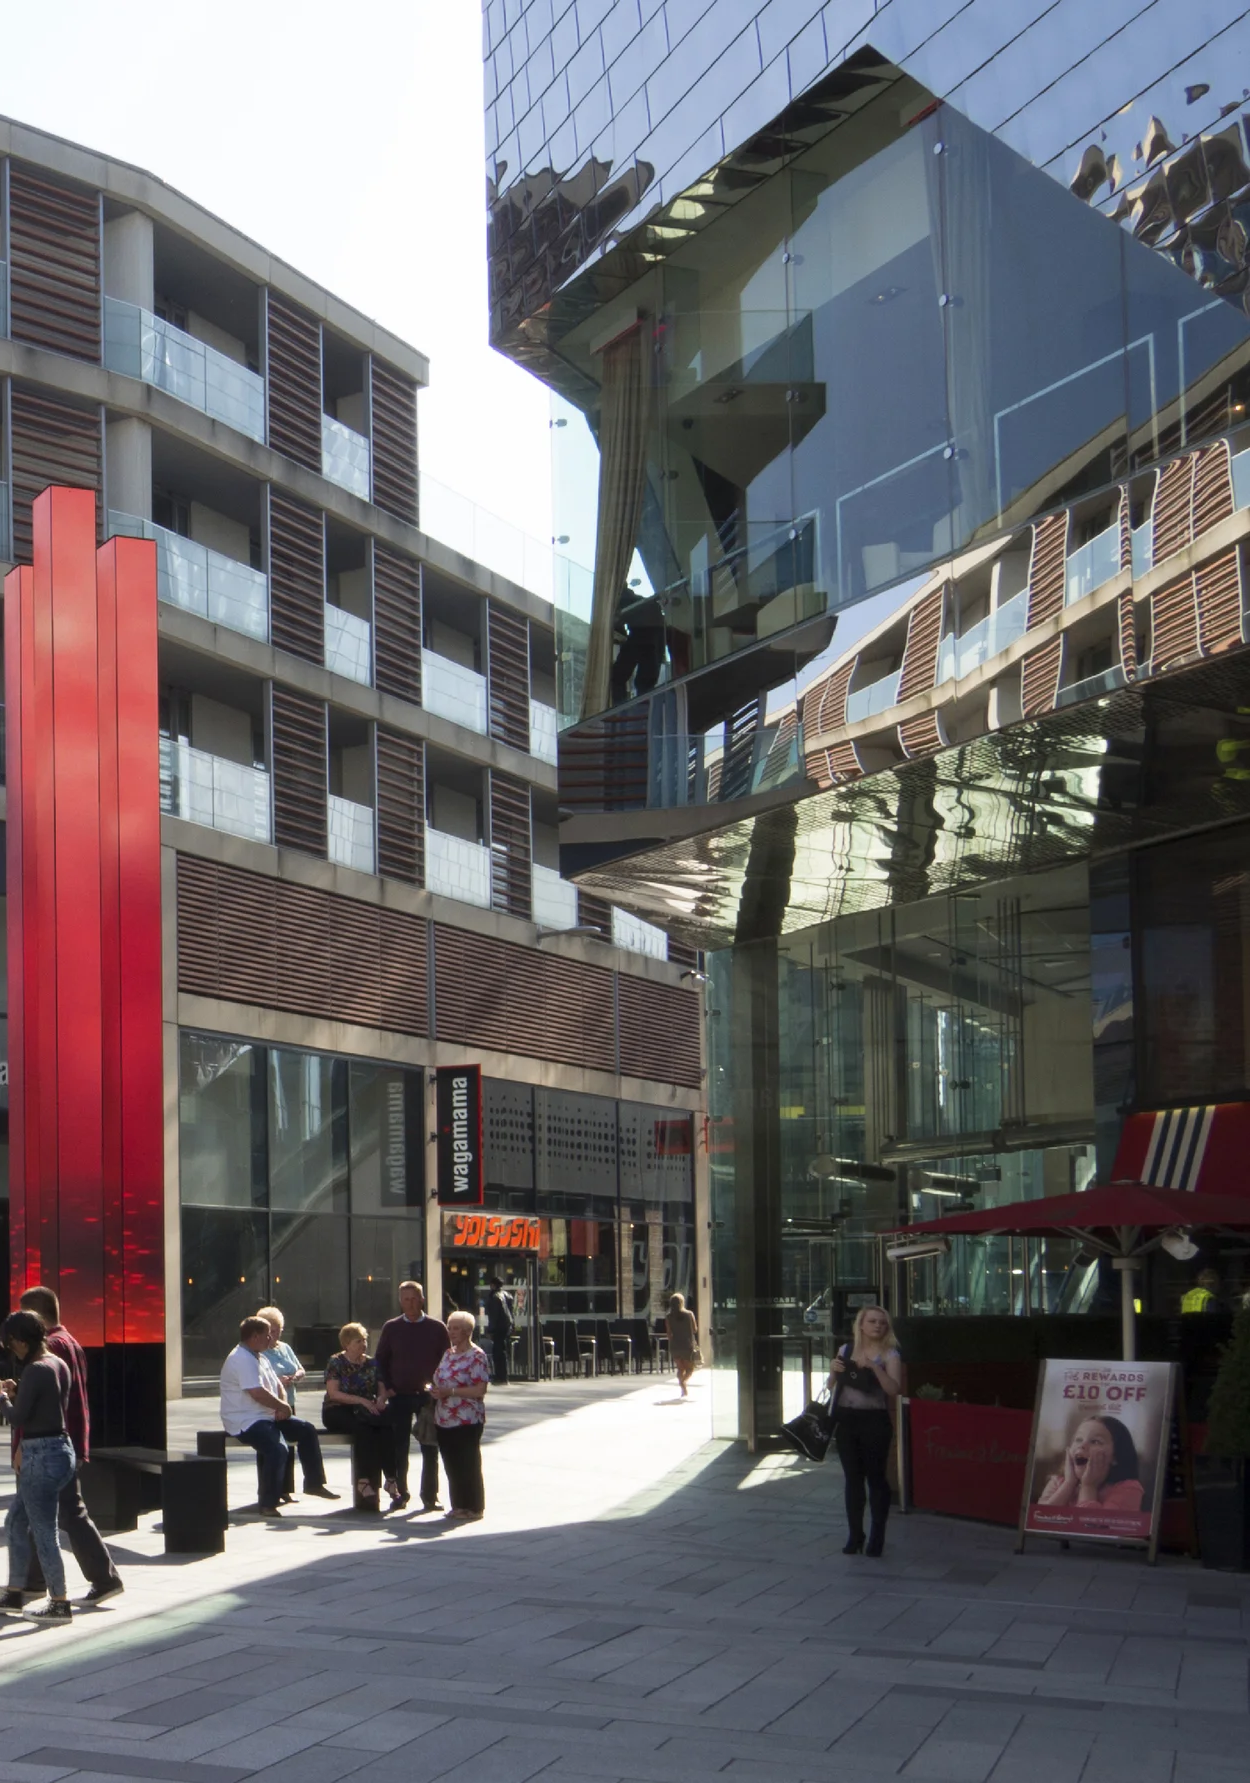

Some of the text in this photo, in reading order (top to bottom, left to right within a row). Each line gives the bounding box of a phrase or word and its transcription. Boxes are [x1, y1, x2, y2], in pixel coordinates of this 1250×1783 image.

[452, 1077, 473, 1192] wagamama
[1083, 1372, 1144, 1382] REWARDS
[1063, 1384, 1147, 1401] £10 OFF
